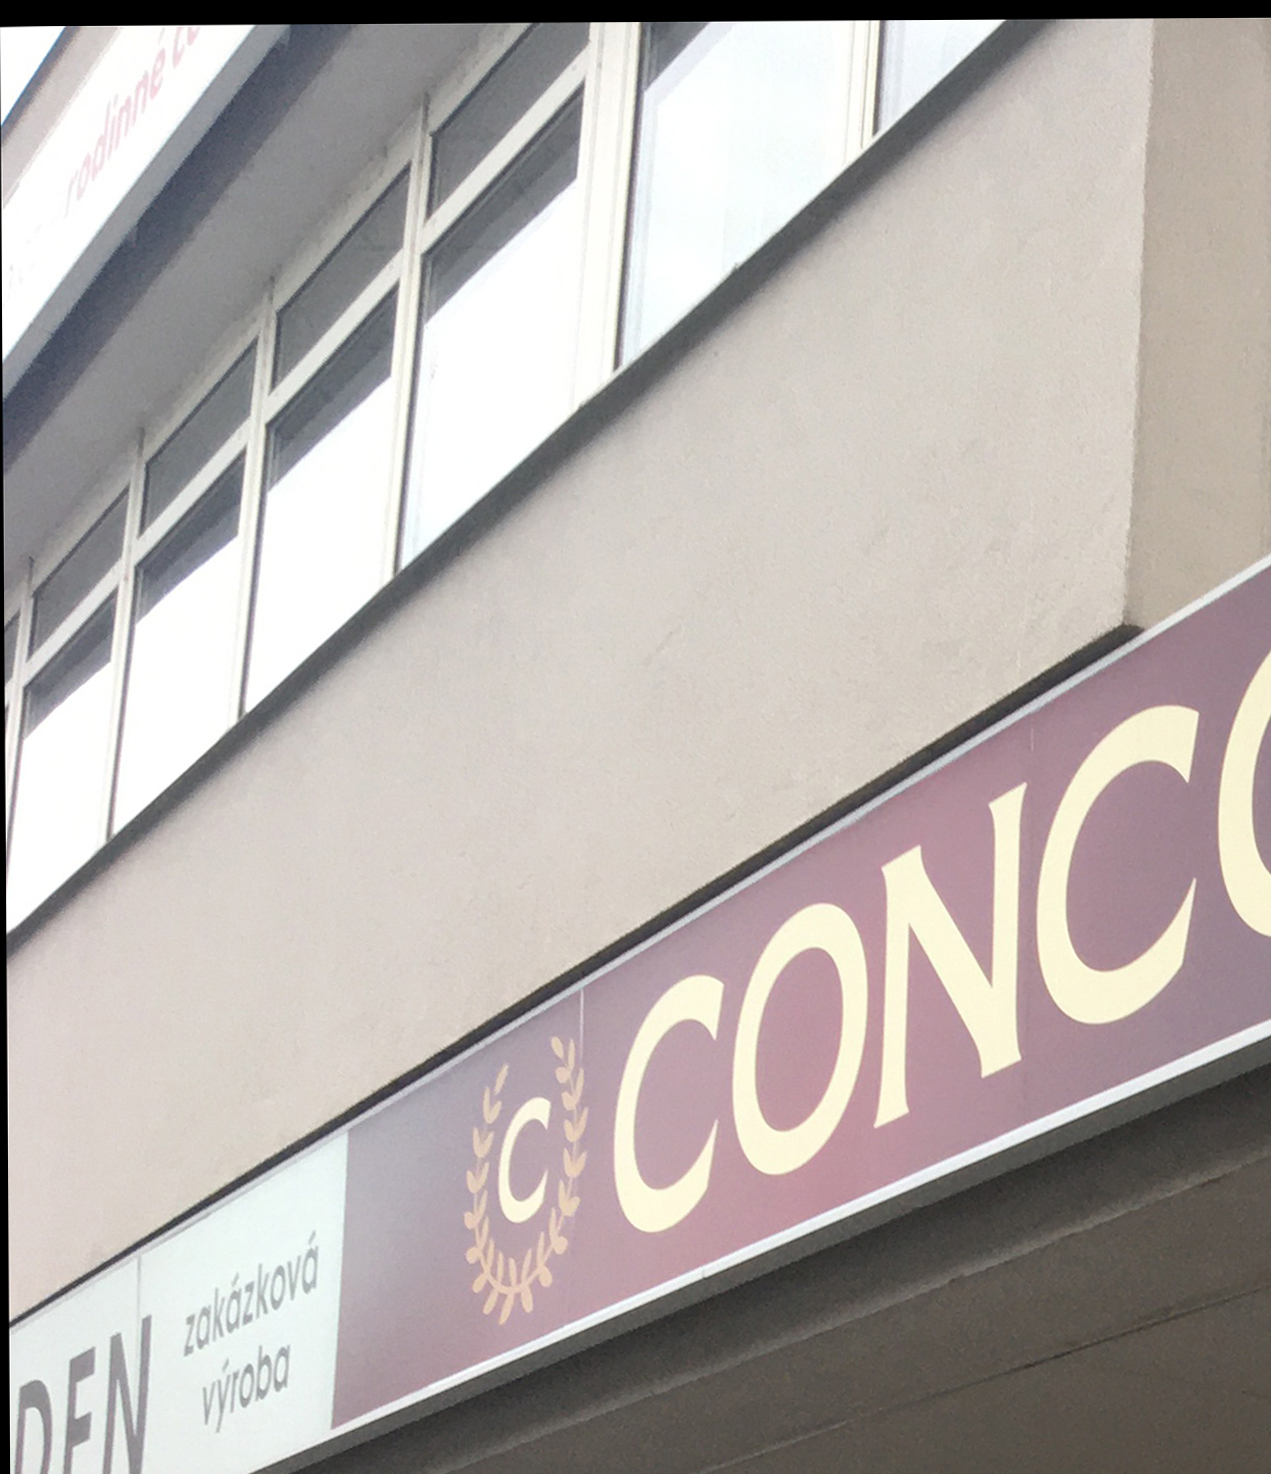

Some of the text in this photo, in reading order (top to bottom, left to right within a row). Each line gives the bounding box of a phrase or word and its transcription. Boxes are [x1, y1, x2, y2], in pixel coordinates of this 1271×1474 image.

[498, 1096, 551, 1223] C
[183, 1230, 319, 1357] zakázková
[202, 1344, 291, 1433] výroba
